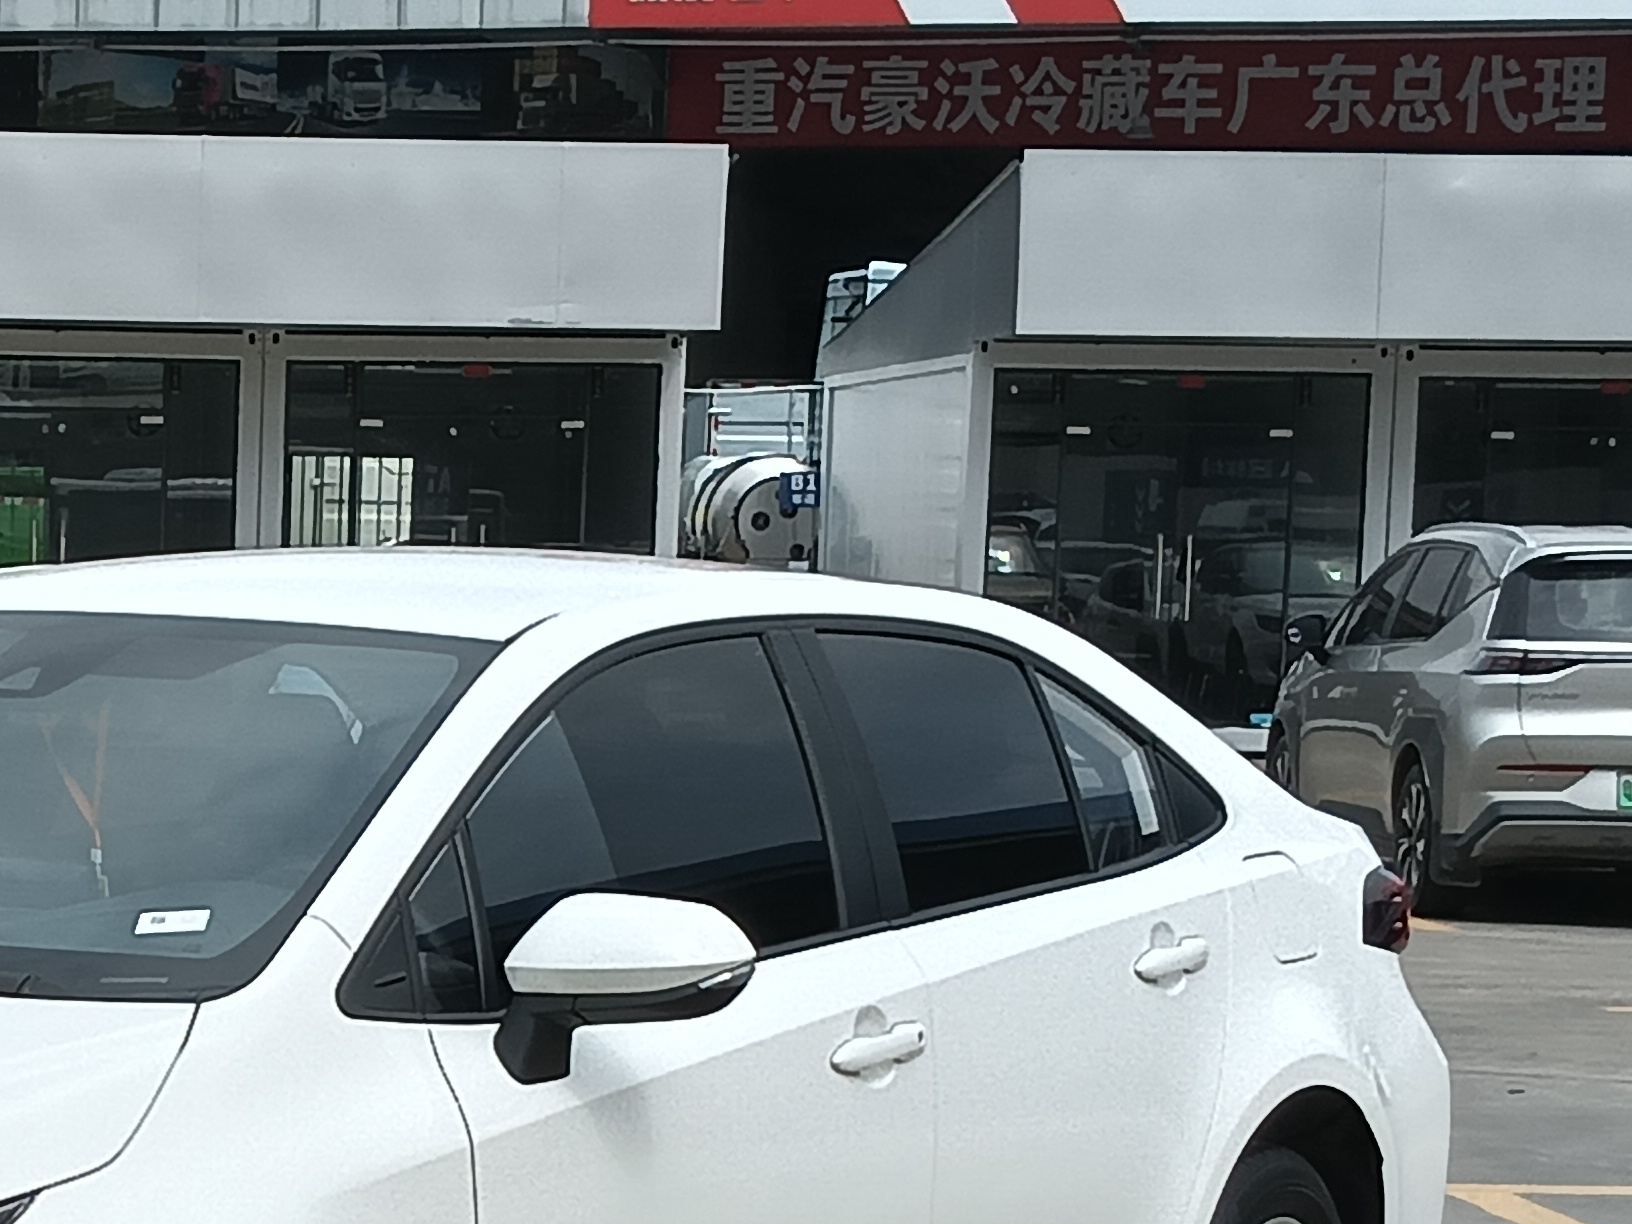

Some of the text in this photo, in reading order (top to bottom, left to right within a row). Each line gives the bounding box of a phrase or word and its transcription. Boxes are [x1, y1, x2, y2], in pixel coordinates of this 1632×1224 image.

[714, 53, 1608, 135] 重汽豪沃冷藏车广东总代理
[791, 474, 816, 490] B1
